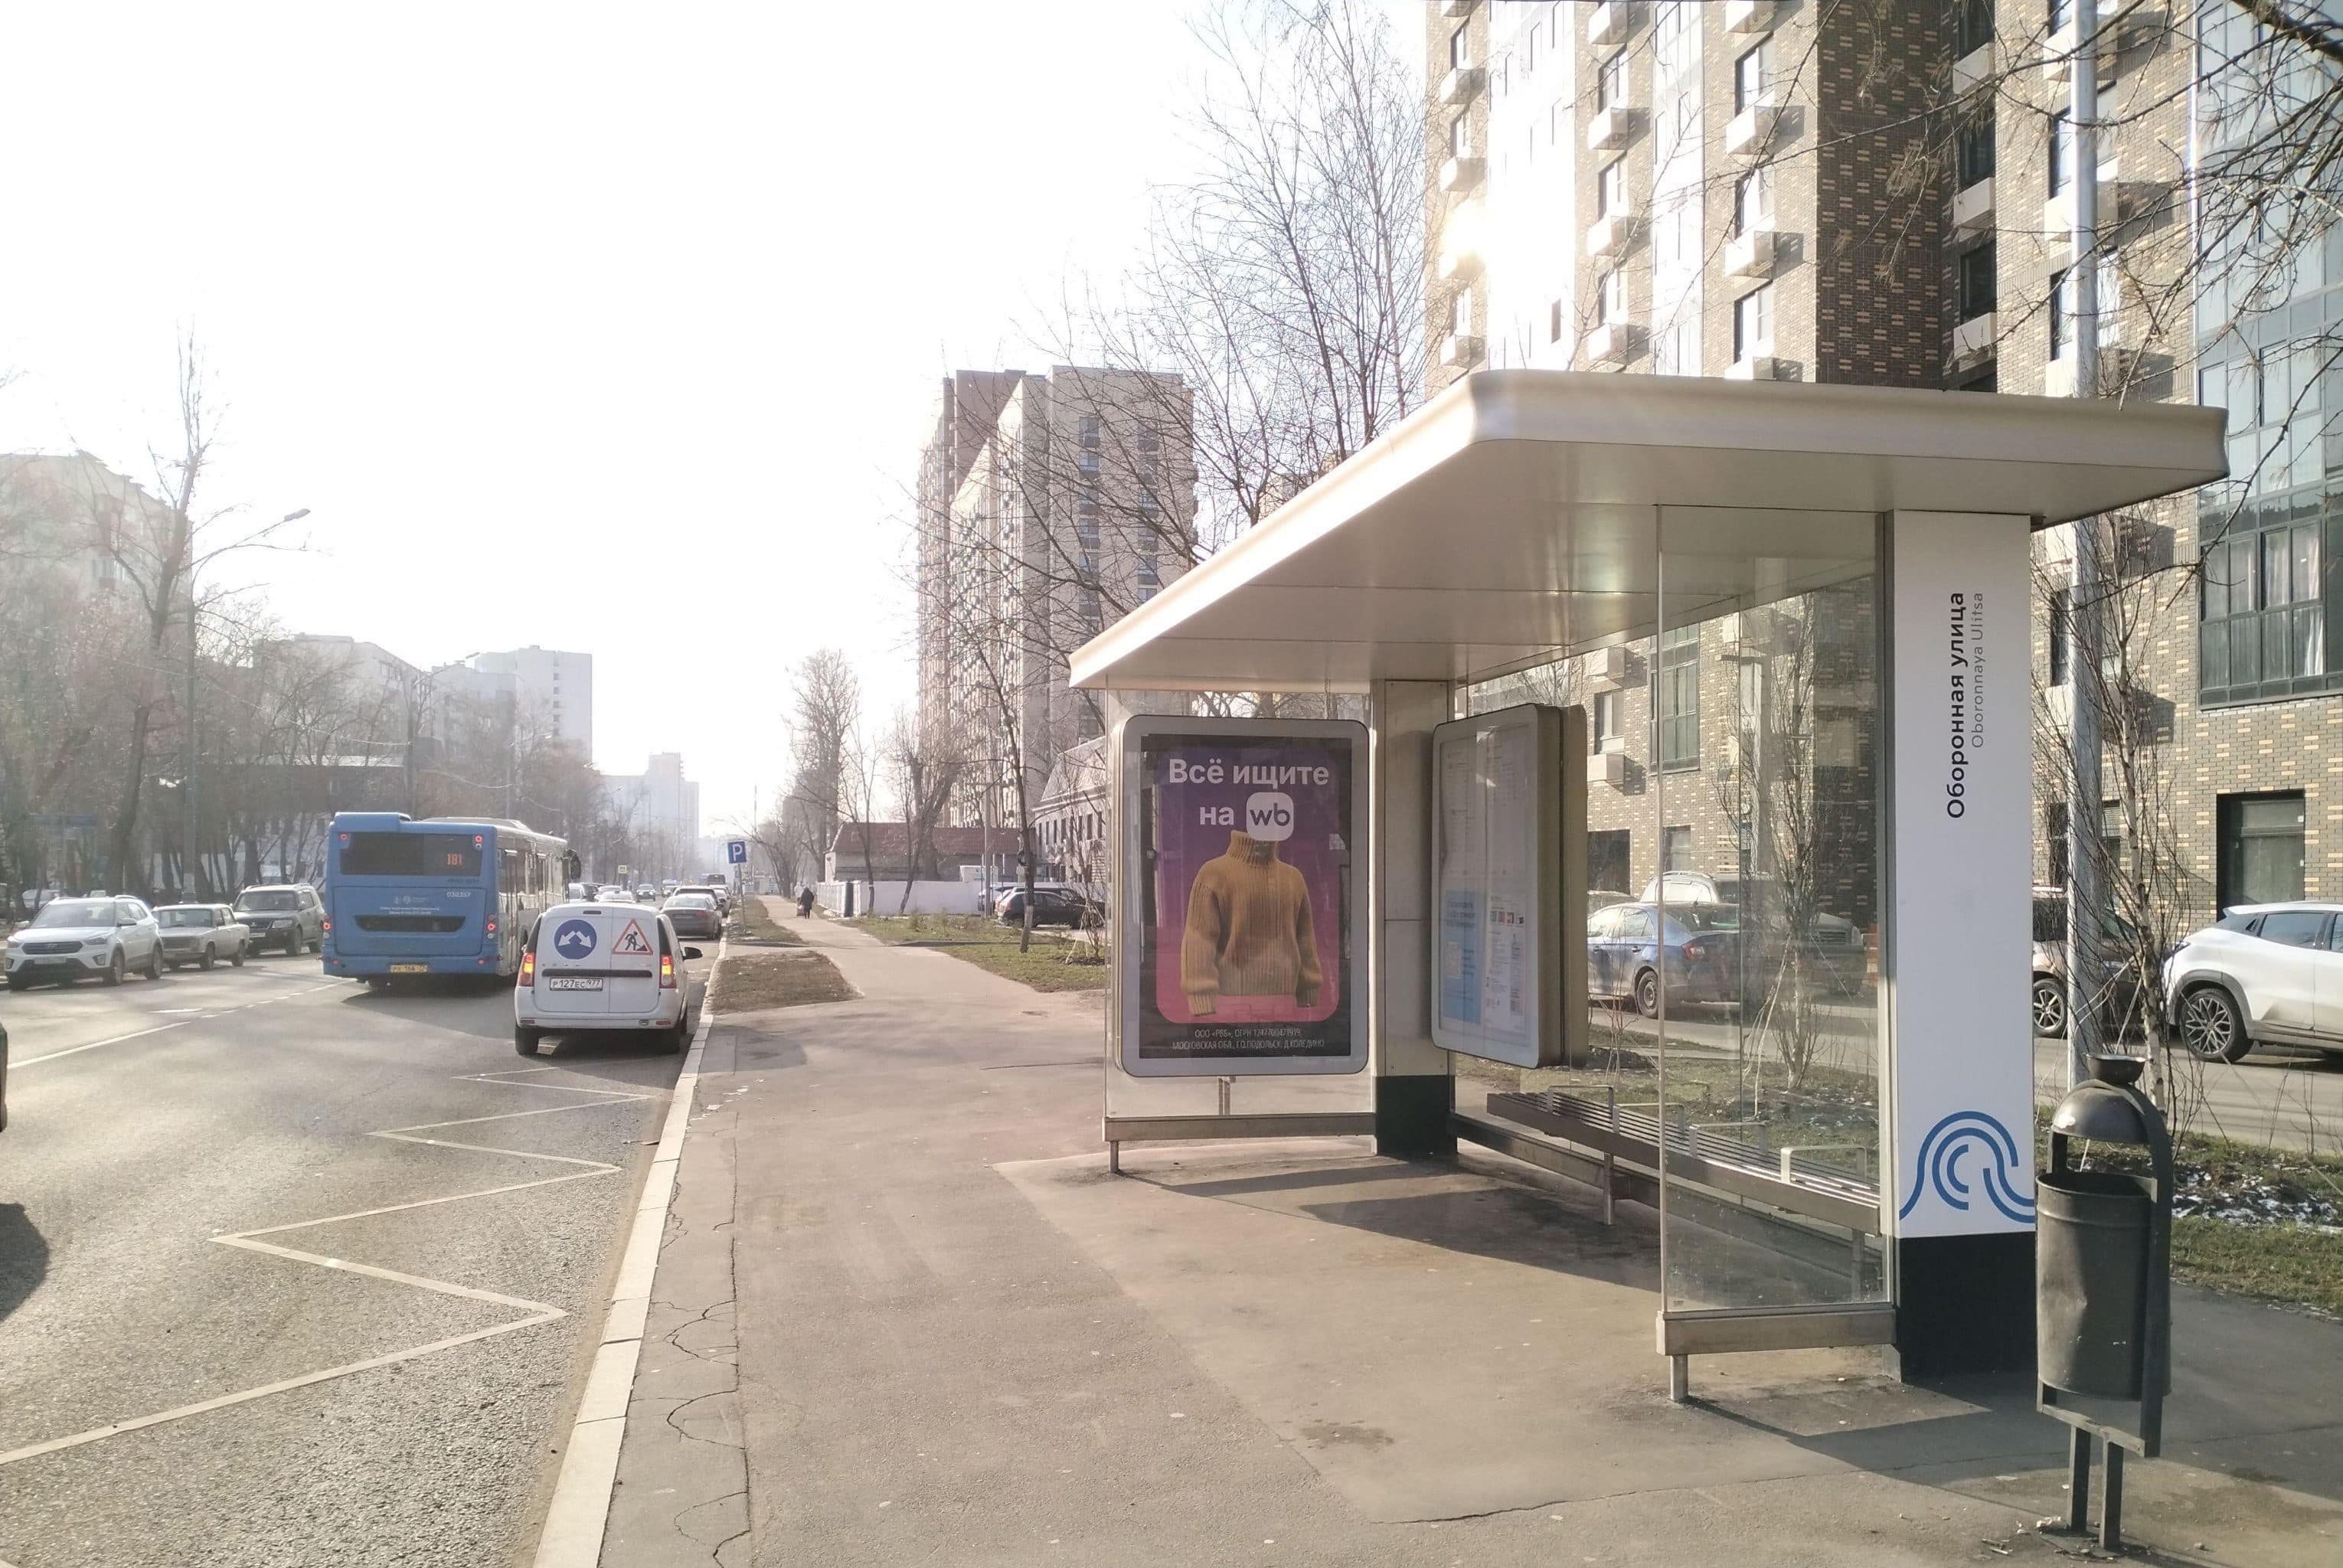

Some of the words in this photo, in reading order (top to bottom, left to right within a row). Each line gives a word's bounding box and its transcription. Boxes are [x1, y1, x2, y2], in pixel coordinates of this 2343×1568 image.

[1951, 593, 1968, 667] улица
[1971, 593, 1983, 641] Ulitsa
[1972, 647, 1985, 748] Oboronnaya
[1946, 675, 1969, 818] Оборонная
[1169, 758, 1224, 784] Всё
[1233, 766, 1329, 789] ищите
[1200, 806, 1234, 825] на
[1249, 802, 1291, 826] wb
[732, 844, 743, 861] P
[1172, 1040, 1217, 1050] МОСКОВСКАЯ
[1194, 1029, 1210, 1038] ООО
[1234, 1028, 1251, 1037] ОГРН
